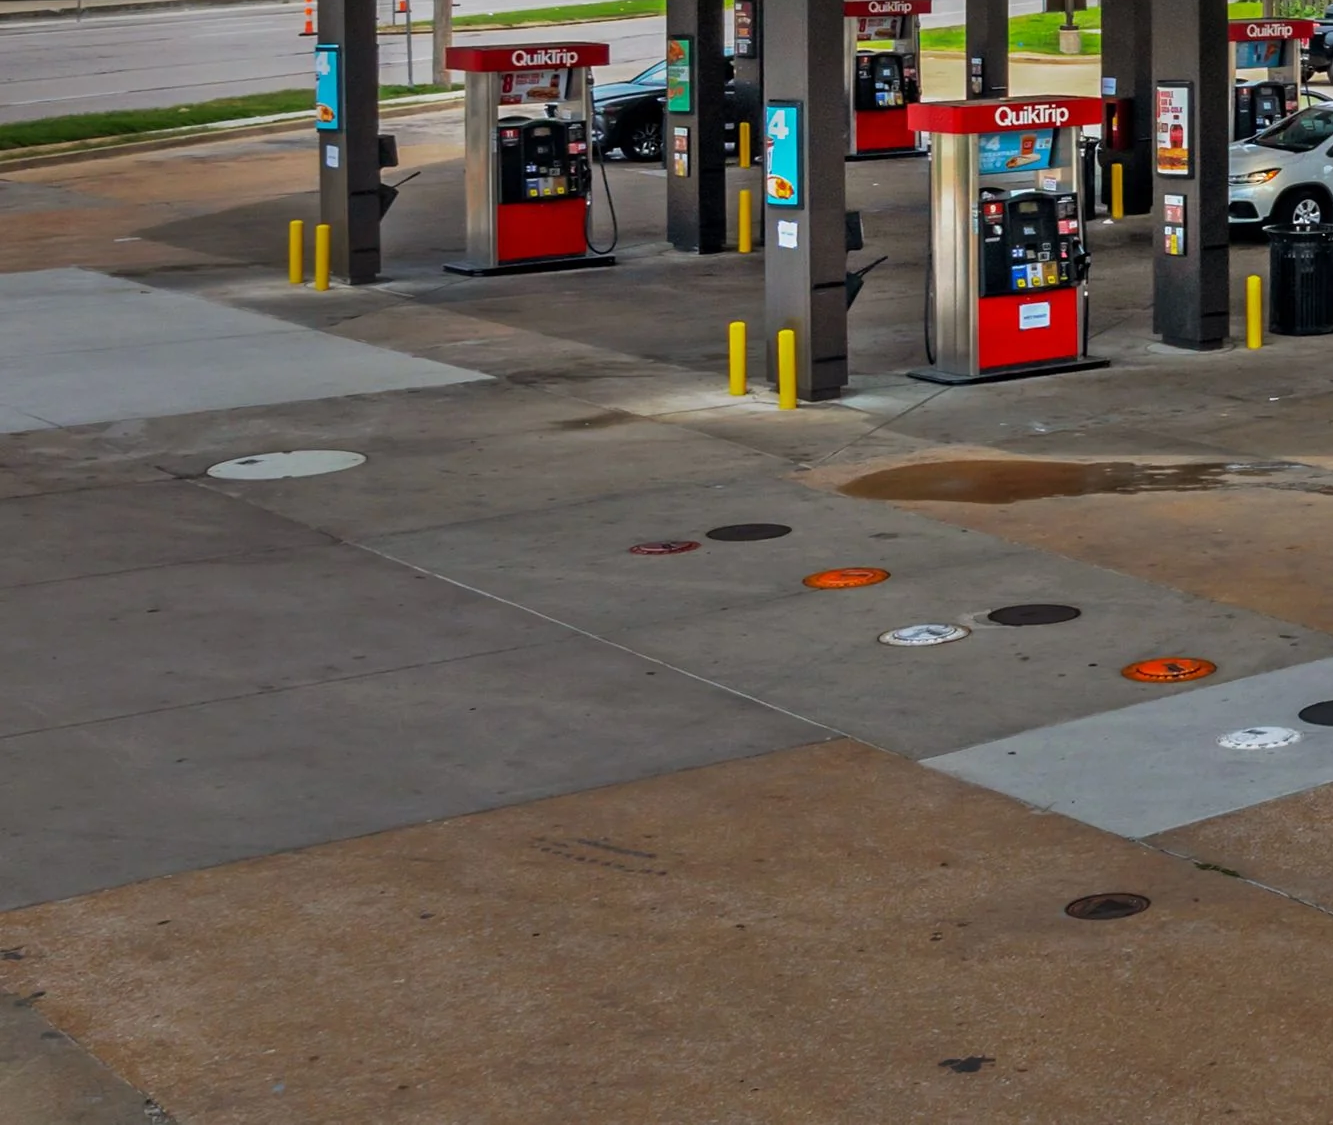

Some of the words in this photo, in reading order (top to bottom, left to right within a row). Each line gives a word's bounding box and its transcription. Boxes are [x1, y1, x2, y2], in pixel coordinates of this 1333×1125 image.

[868, 1, 912, 13] QuikTrip
[1247, 24, 1293, 38] QuikTrip
[511, 49, 579, 66] QuikTrip
[994, 104, 1069, 126] QuikTrip
[768, 110, 789, 140] 4
[990, 205, 996, 213] 9
